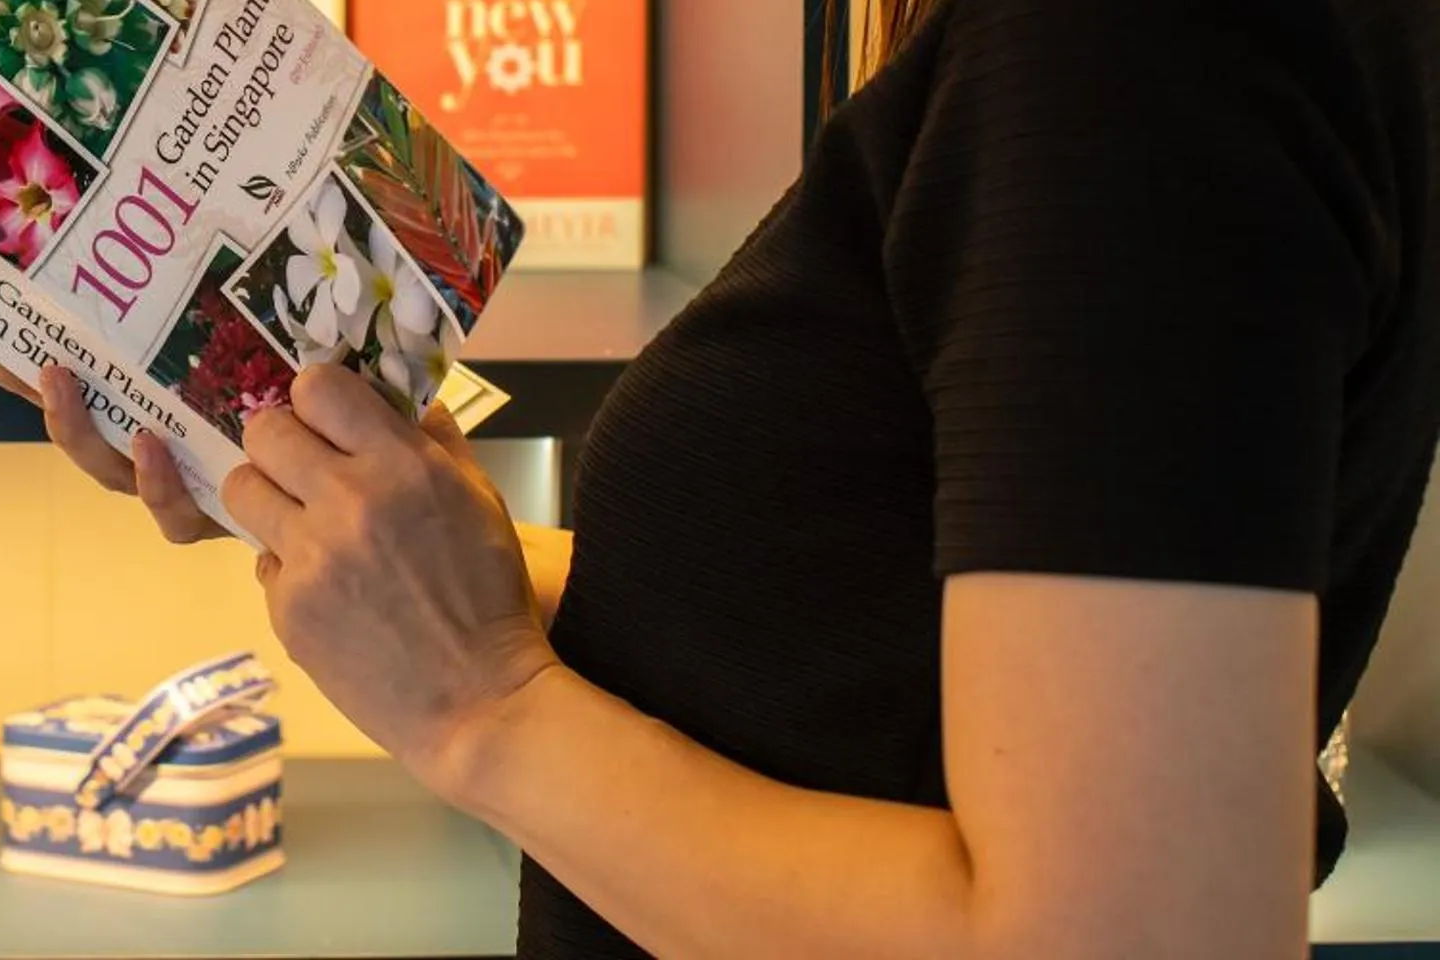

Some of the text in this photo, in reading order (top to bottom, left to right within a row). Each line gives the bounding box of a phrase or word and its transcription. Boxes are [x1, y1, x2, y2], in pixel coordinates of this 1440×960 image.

[156, 63, 230, 165] Garden
[185, 23, 295, 195] in Singapore
[440, 40, 585, 113] you
[71, 166, 201, 323] 1001
[11, 328, 153, 435] Sinapor
[105, 361, 187, 439] Plants
